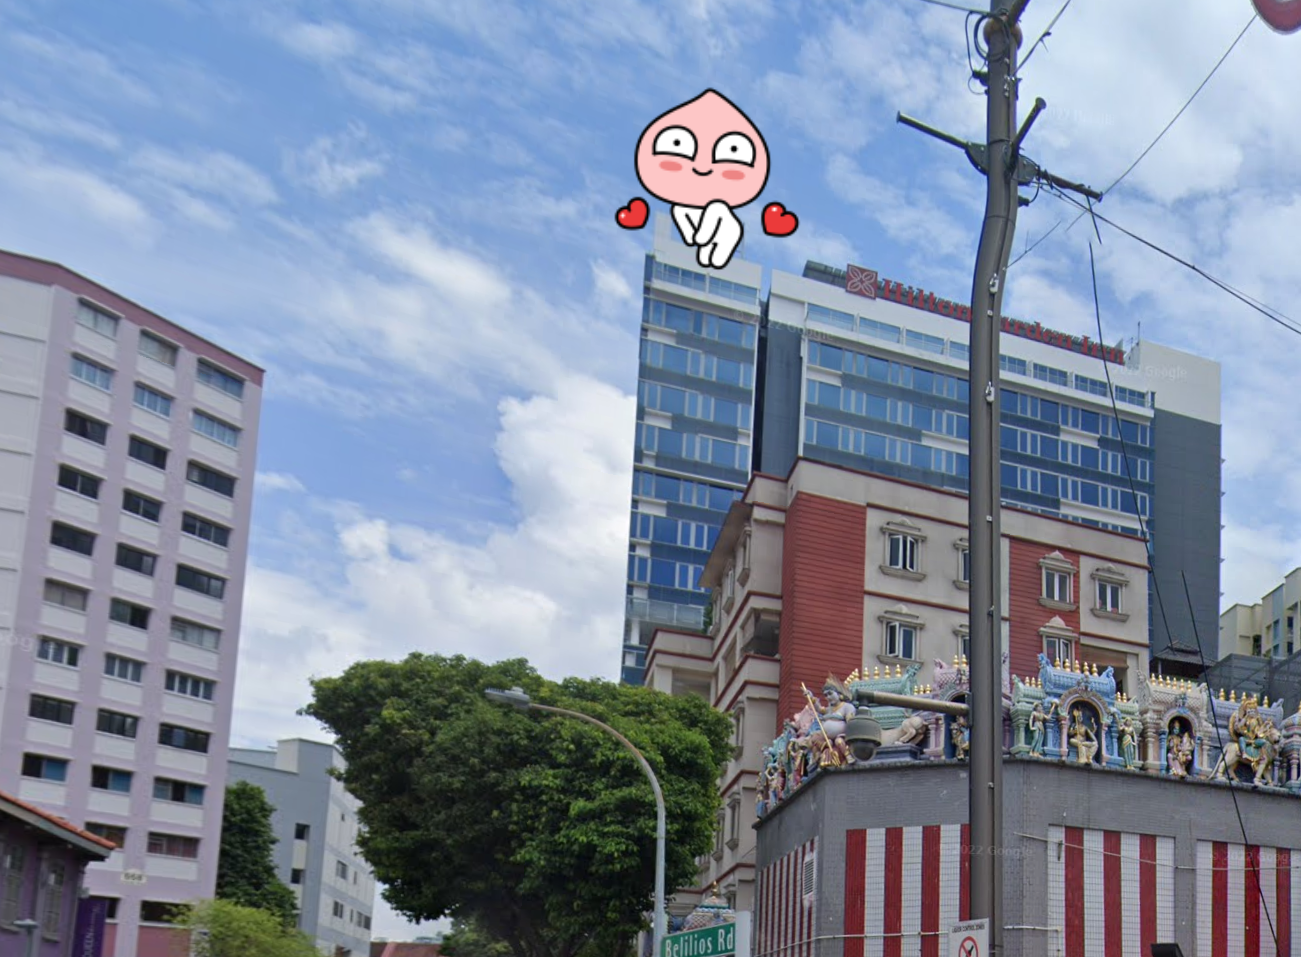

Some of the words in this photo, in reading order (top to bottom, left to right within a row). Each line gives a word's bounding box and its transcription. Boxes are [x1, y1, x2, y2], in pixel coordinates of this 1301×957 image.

[883, 278, 972, 322] Hilton
[1000, 316, 1073, 350] arden
[1081, 334, 1125, 366] Inn
[718, 926, 734, 952] Rd
